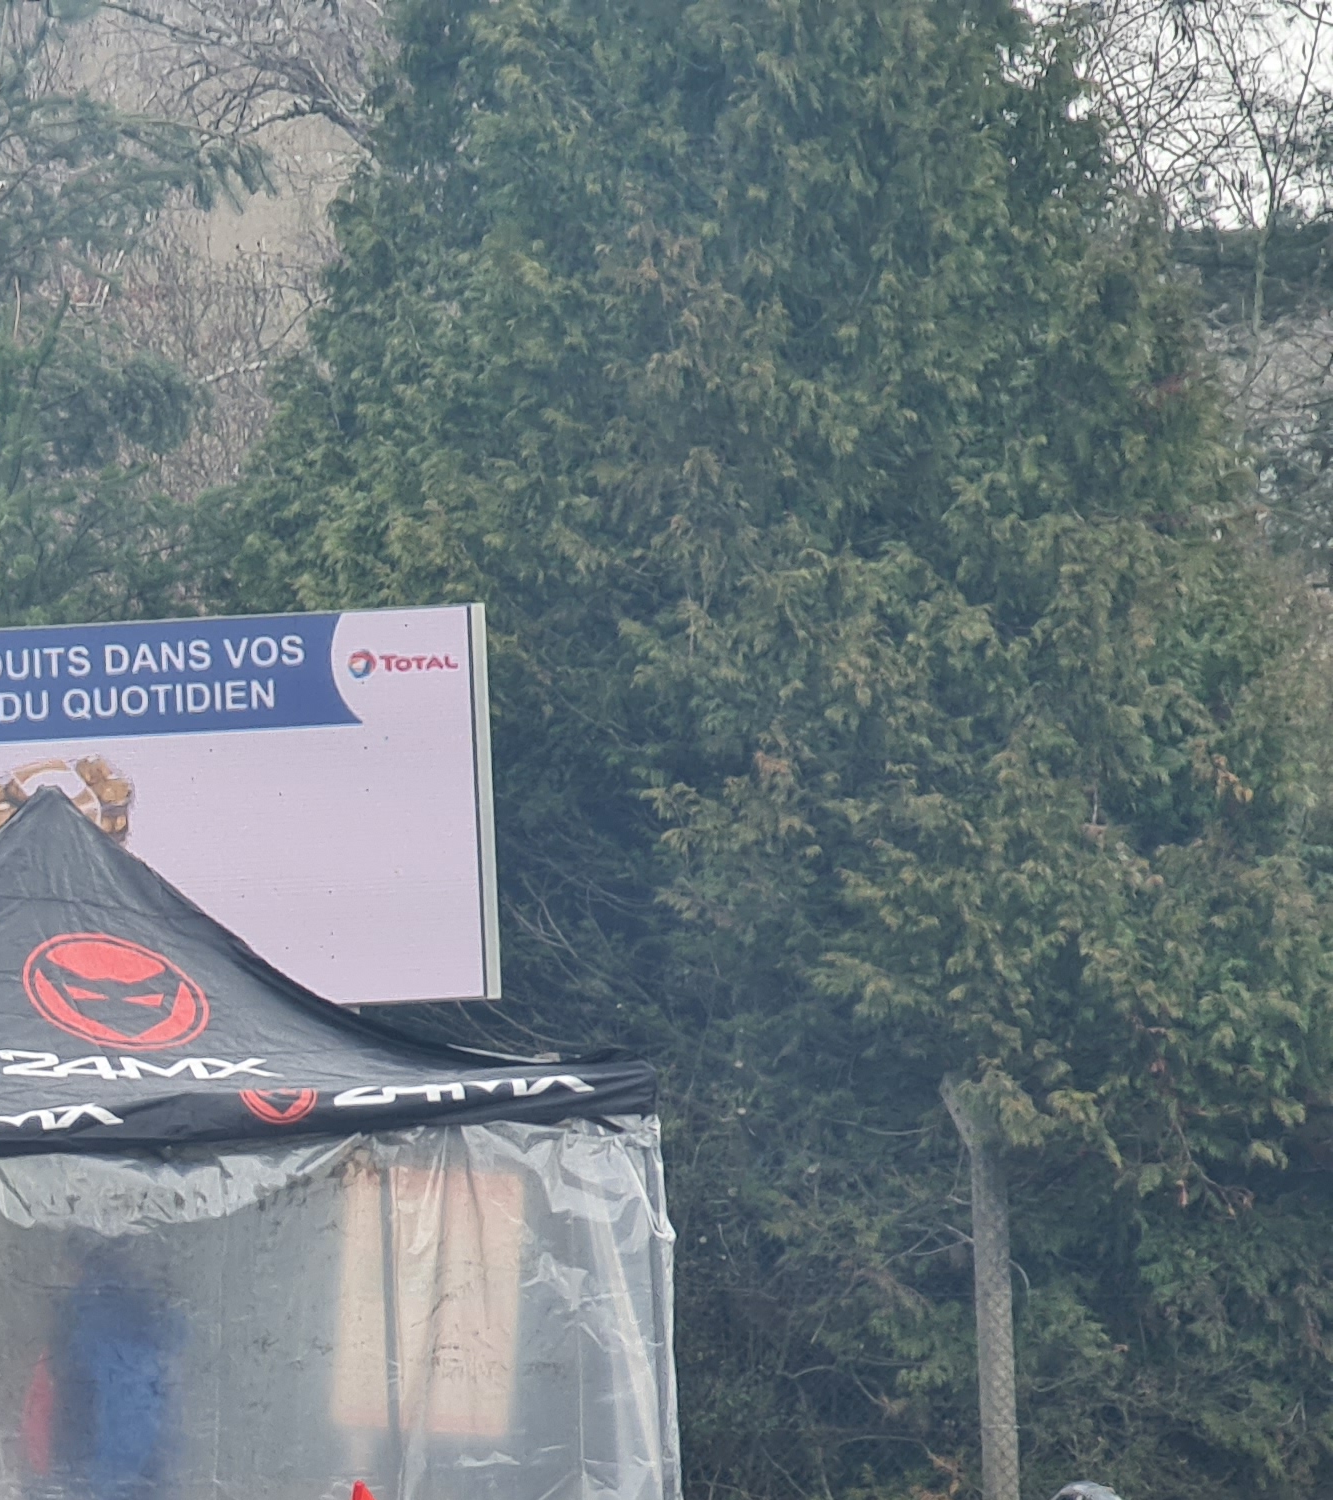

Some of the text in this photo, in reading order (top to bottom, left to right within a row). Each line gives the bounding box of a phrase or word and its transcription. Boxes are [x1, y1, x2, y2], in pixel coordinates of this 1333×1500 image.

[105, 638, 211, 675] DANS
[223, 635, 305, 668] VOS
[380, 653, 459, 672] TOTAL
[62, 678, 276, 721] QUOTIDIEN
